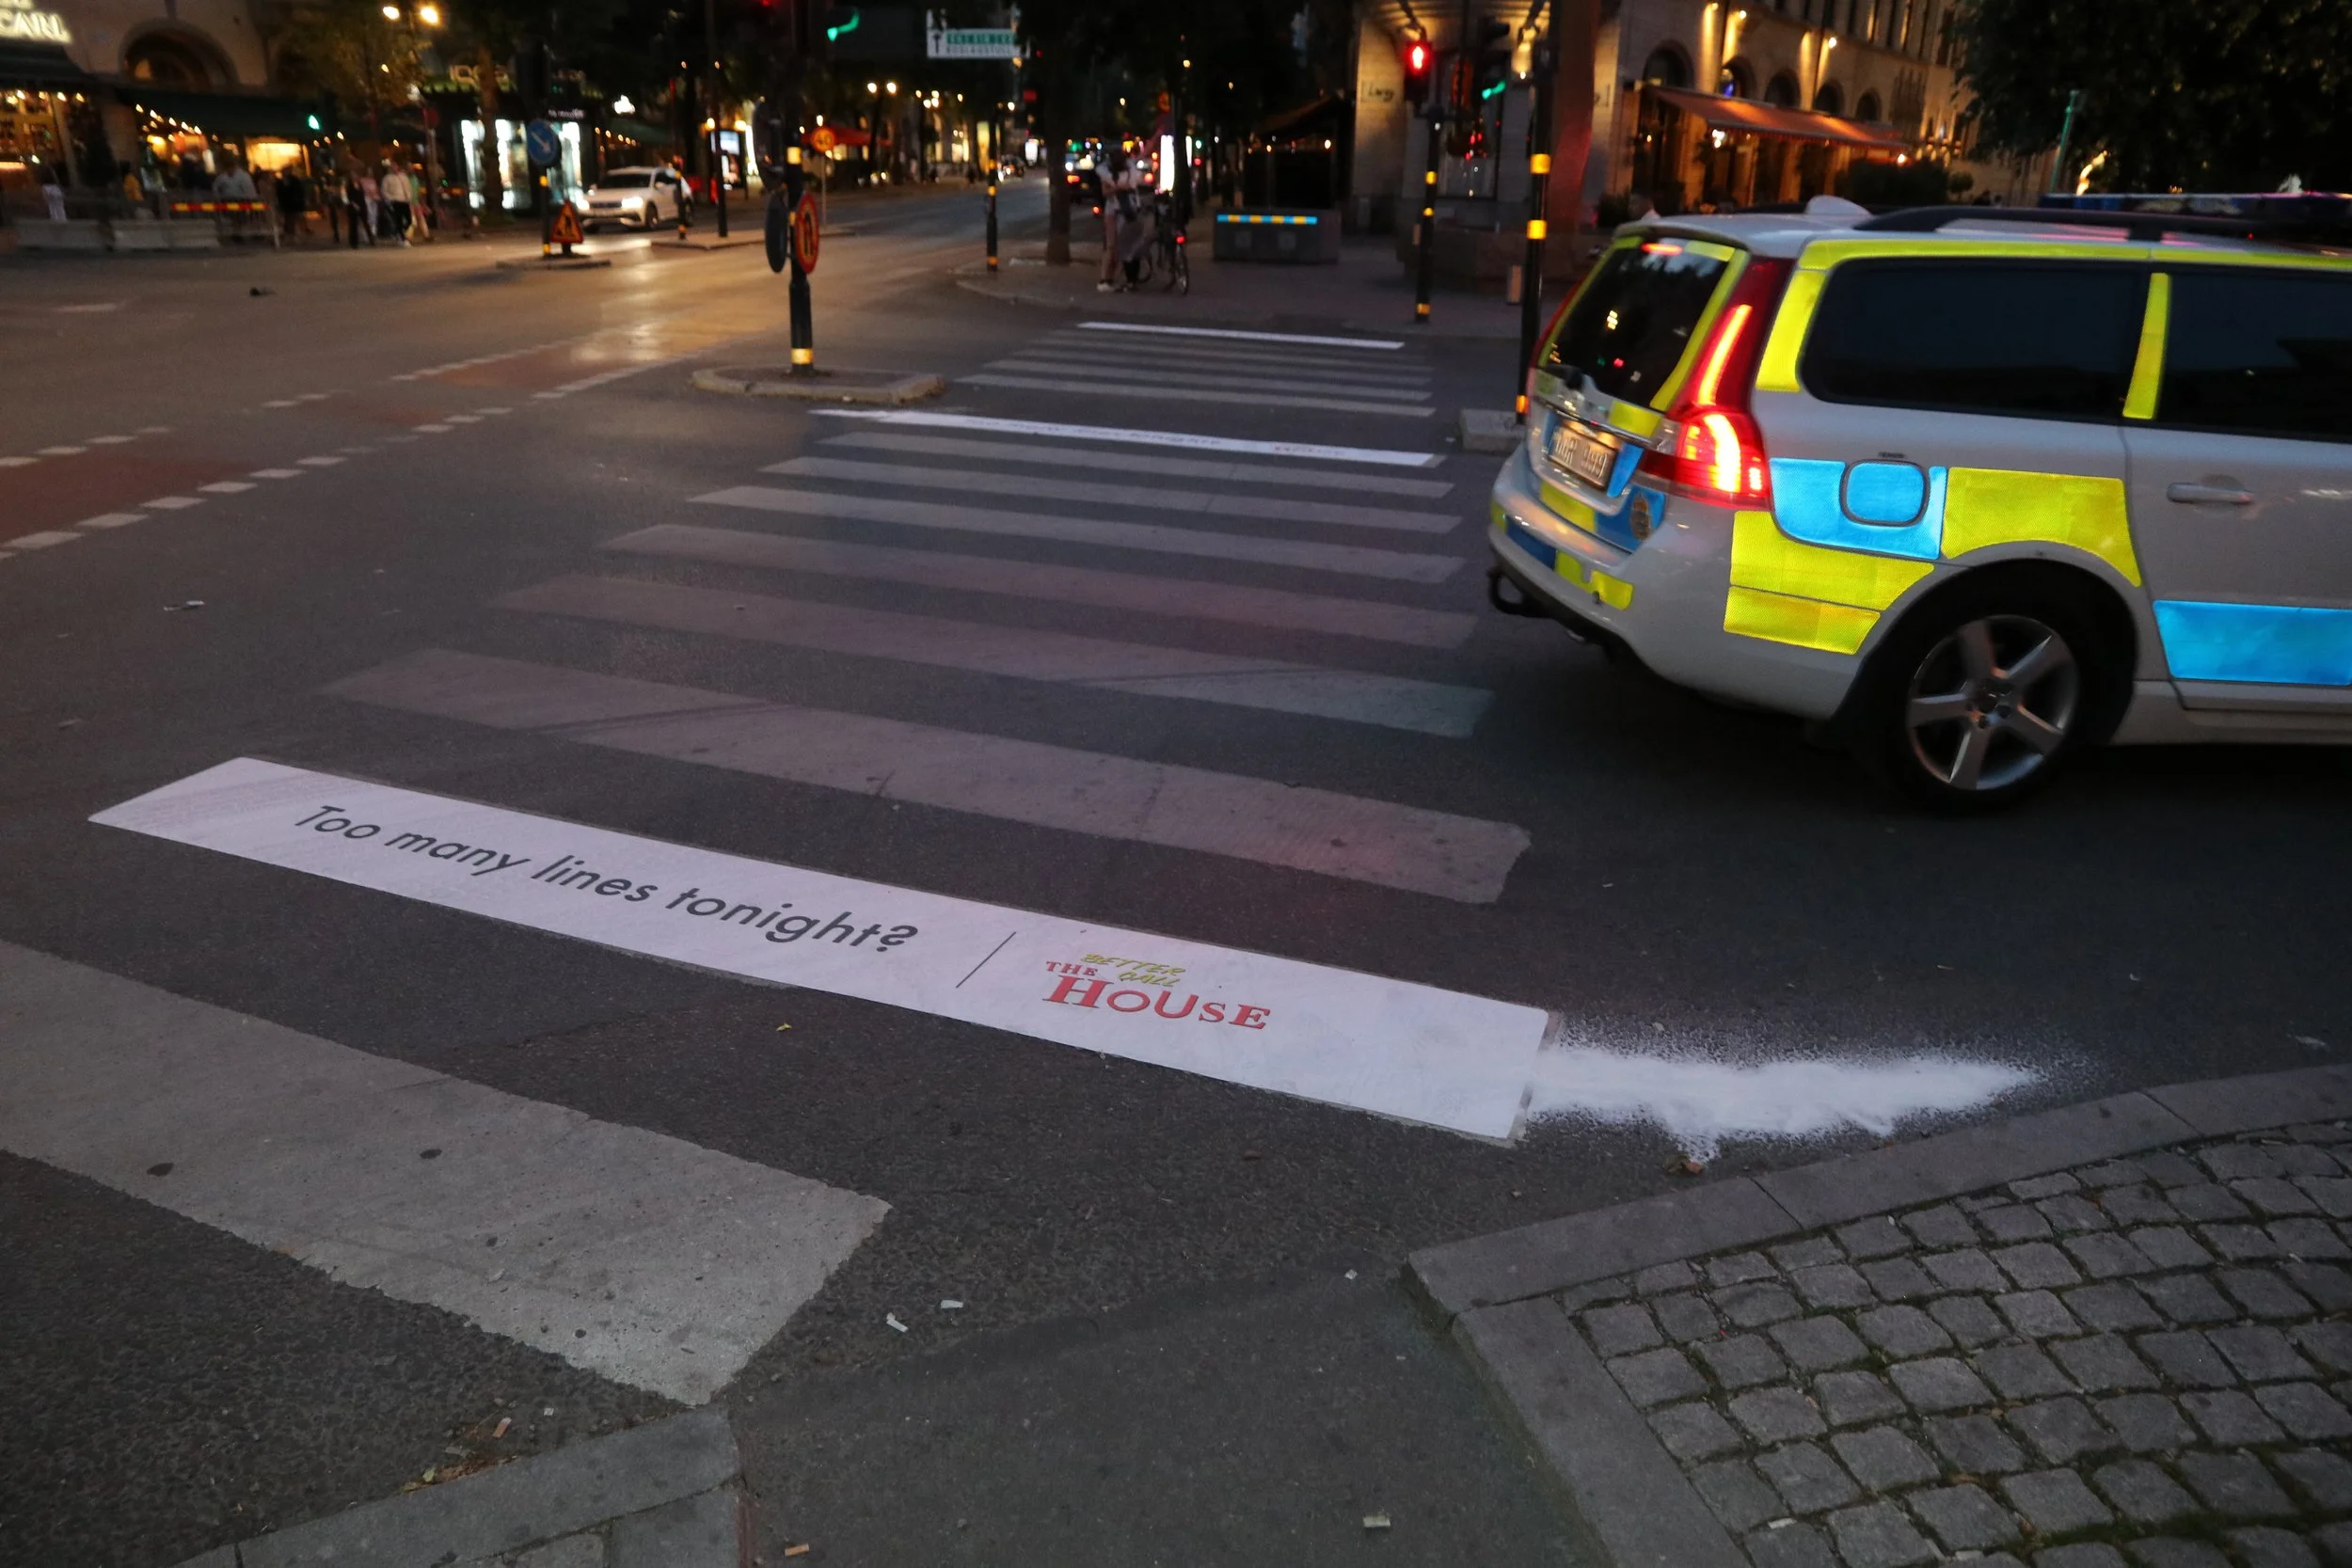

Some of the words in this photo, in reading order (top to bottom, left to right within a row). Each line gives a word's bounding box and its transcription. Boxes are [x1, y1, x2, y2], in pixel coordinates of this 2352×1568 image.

[294, 805, 381, 839] Too
[384, 833, 531, 878] many
[532, 856, 658, 902] lines
[664, 888, 918, 952] tonight?
[1046, 961, 1099, 976] THE
[1081, 954, 1185, 975] BETTER
[1118, 972, 1180, 988] CALL
[1042, 976, 1270, 1030] HOUSE
